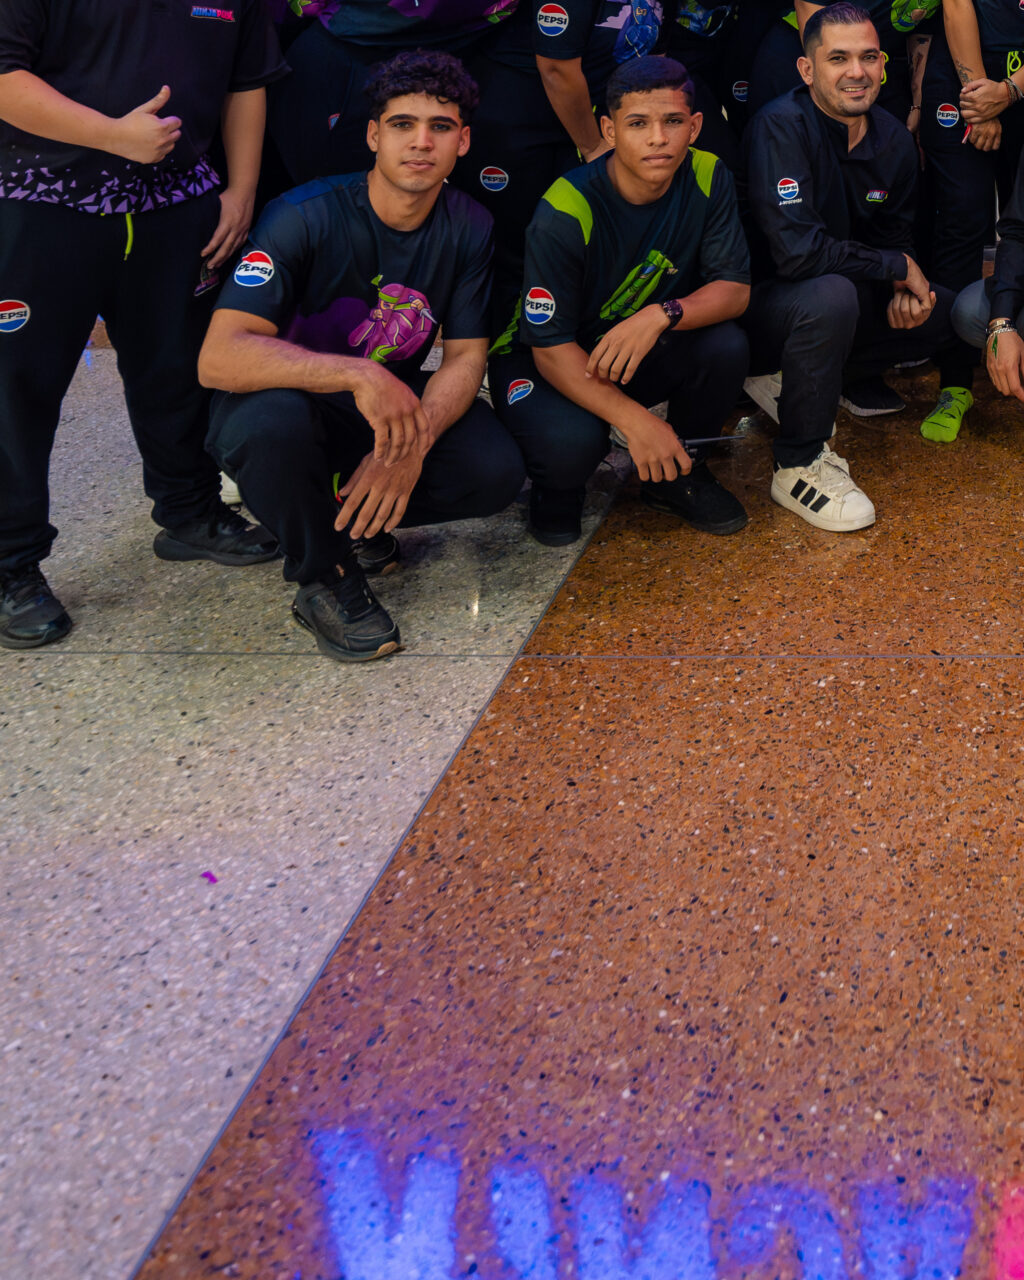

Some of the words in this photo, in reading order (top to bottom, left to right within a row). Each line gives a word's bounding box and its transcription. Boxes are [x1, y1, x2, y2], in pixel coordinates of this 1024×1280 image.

[538, 14, 567, 25] PEPSI
[938, 111, 958, 119] PEPSI
[237, 263, 273, 277] PEPSI
[526, 299, 554, 312] PEPSI
[0, 310, 28, 320] EPSI
